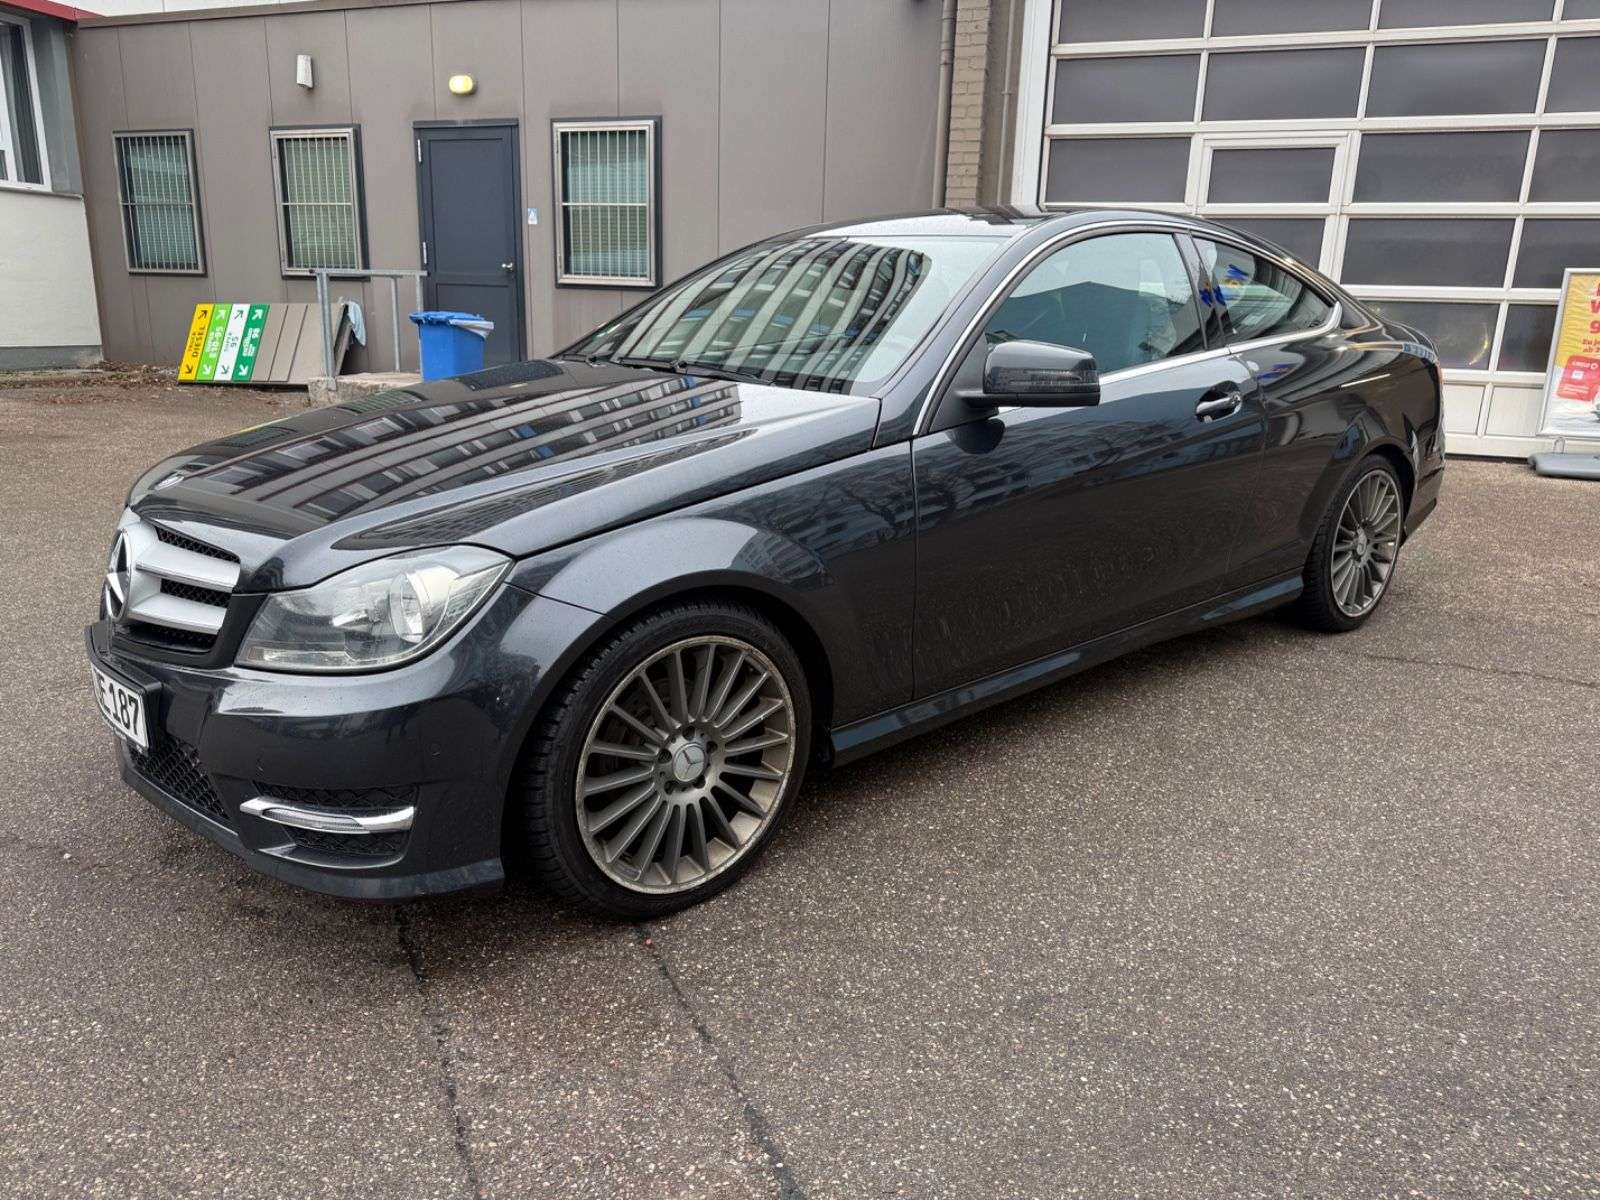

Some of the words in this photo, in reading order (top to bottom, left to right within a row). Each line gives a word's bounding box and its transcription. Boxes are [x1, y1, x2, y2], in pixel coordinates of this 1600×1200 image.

[192, 326, 206, 358] DIESEL
[230, 336, 239, 348] 95
[109, 682, 139, 735] 187
